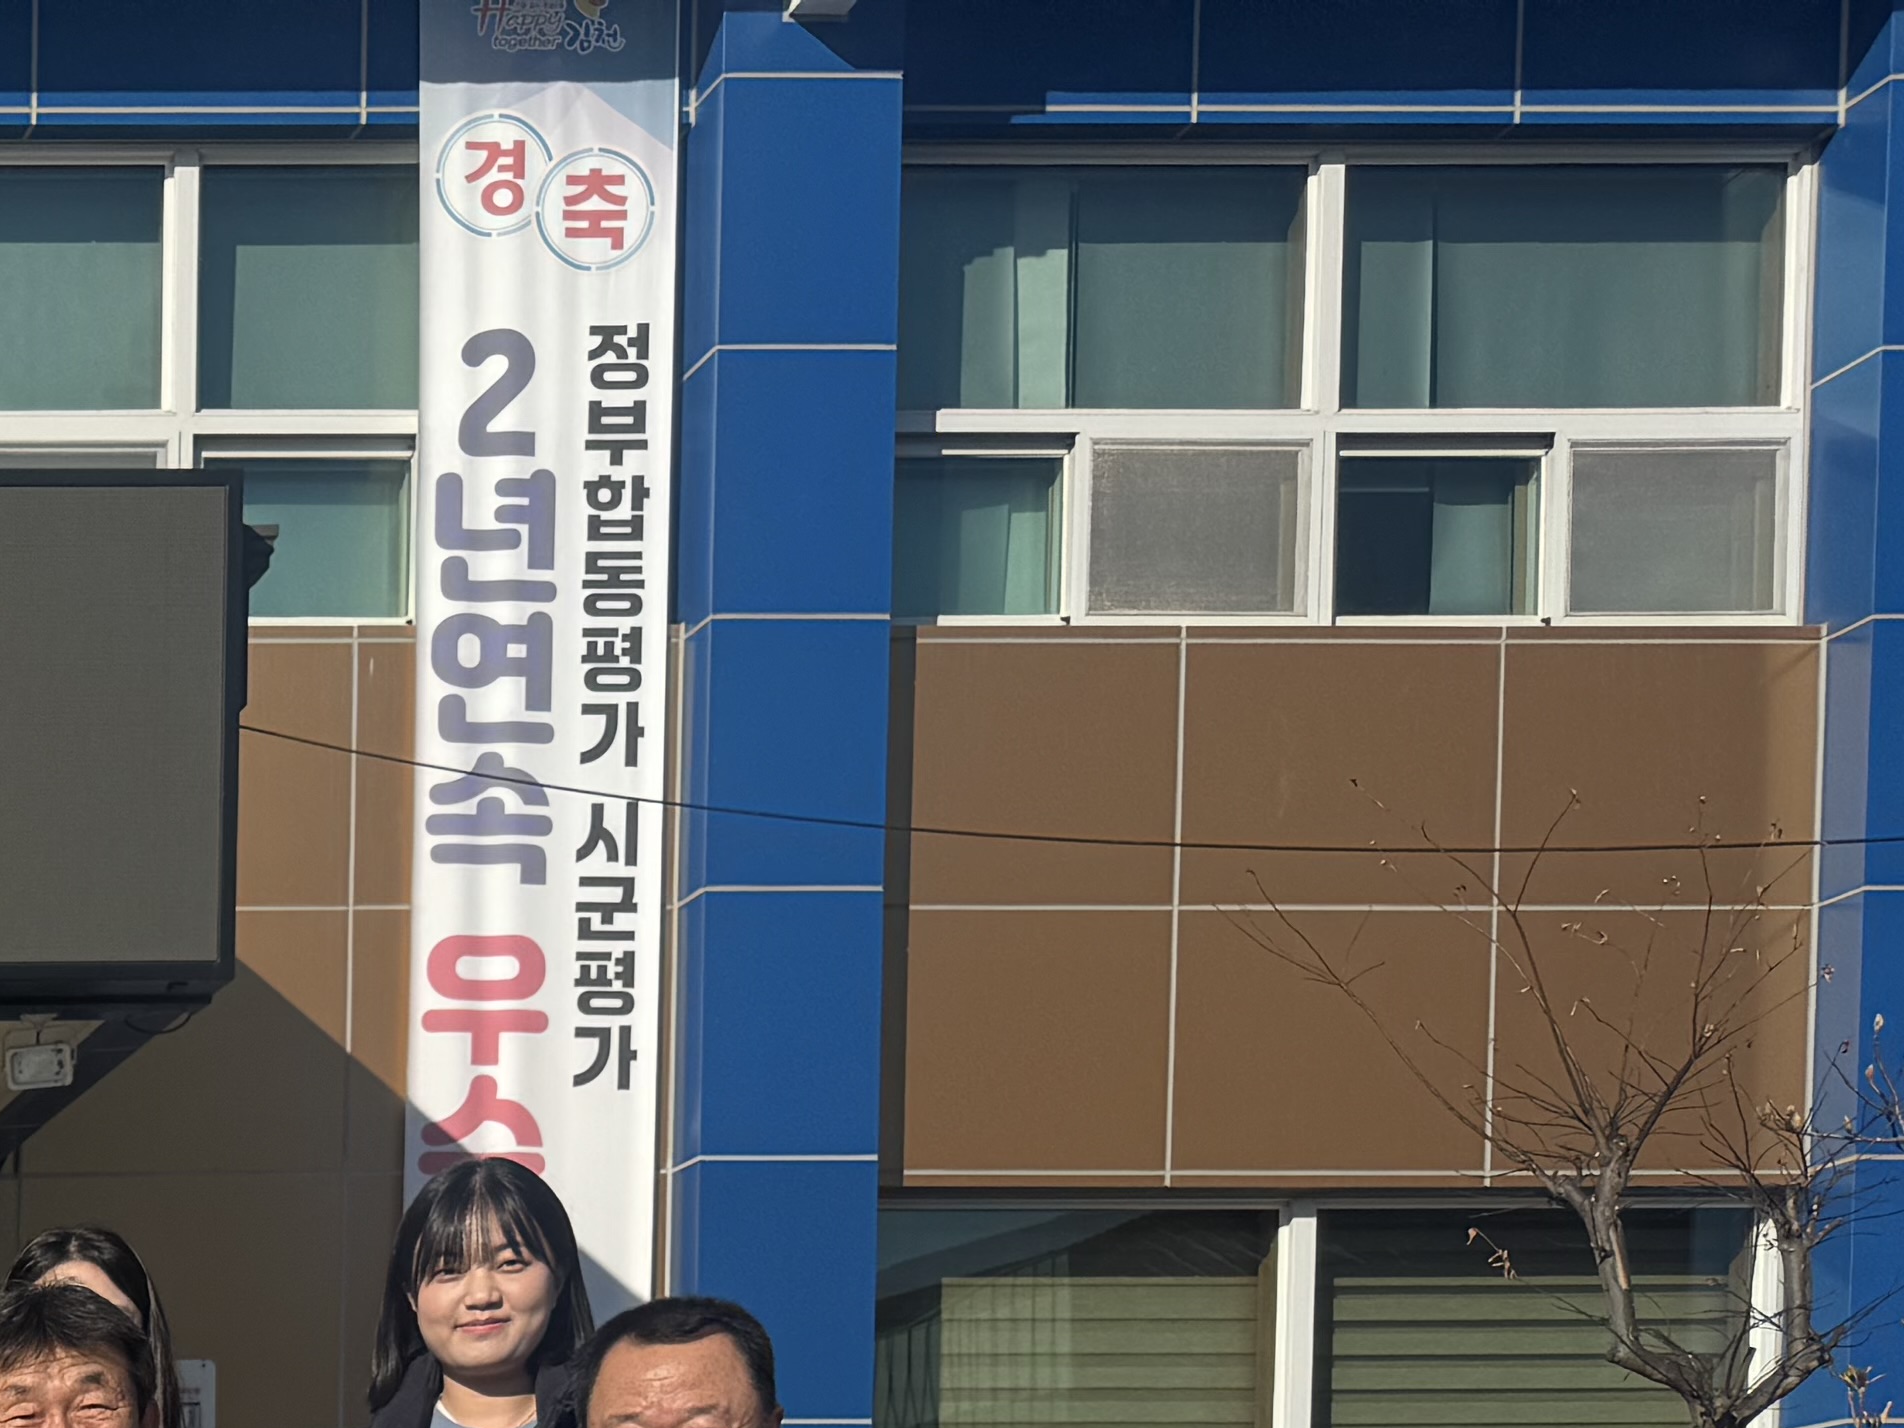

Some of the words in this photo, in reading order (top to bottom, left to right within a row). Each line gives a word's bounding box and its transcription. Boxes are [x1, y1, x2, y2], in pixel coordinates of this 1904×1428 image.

[492, 33, 562, 52] together
[579, 322, 651, 769] 정부합동평가
[572, 802, 640, 1091] 시군평가
